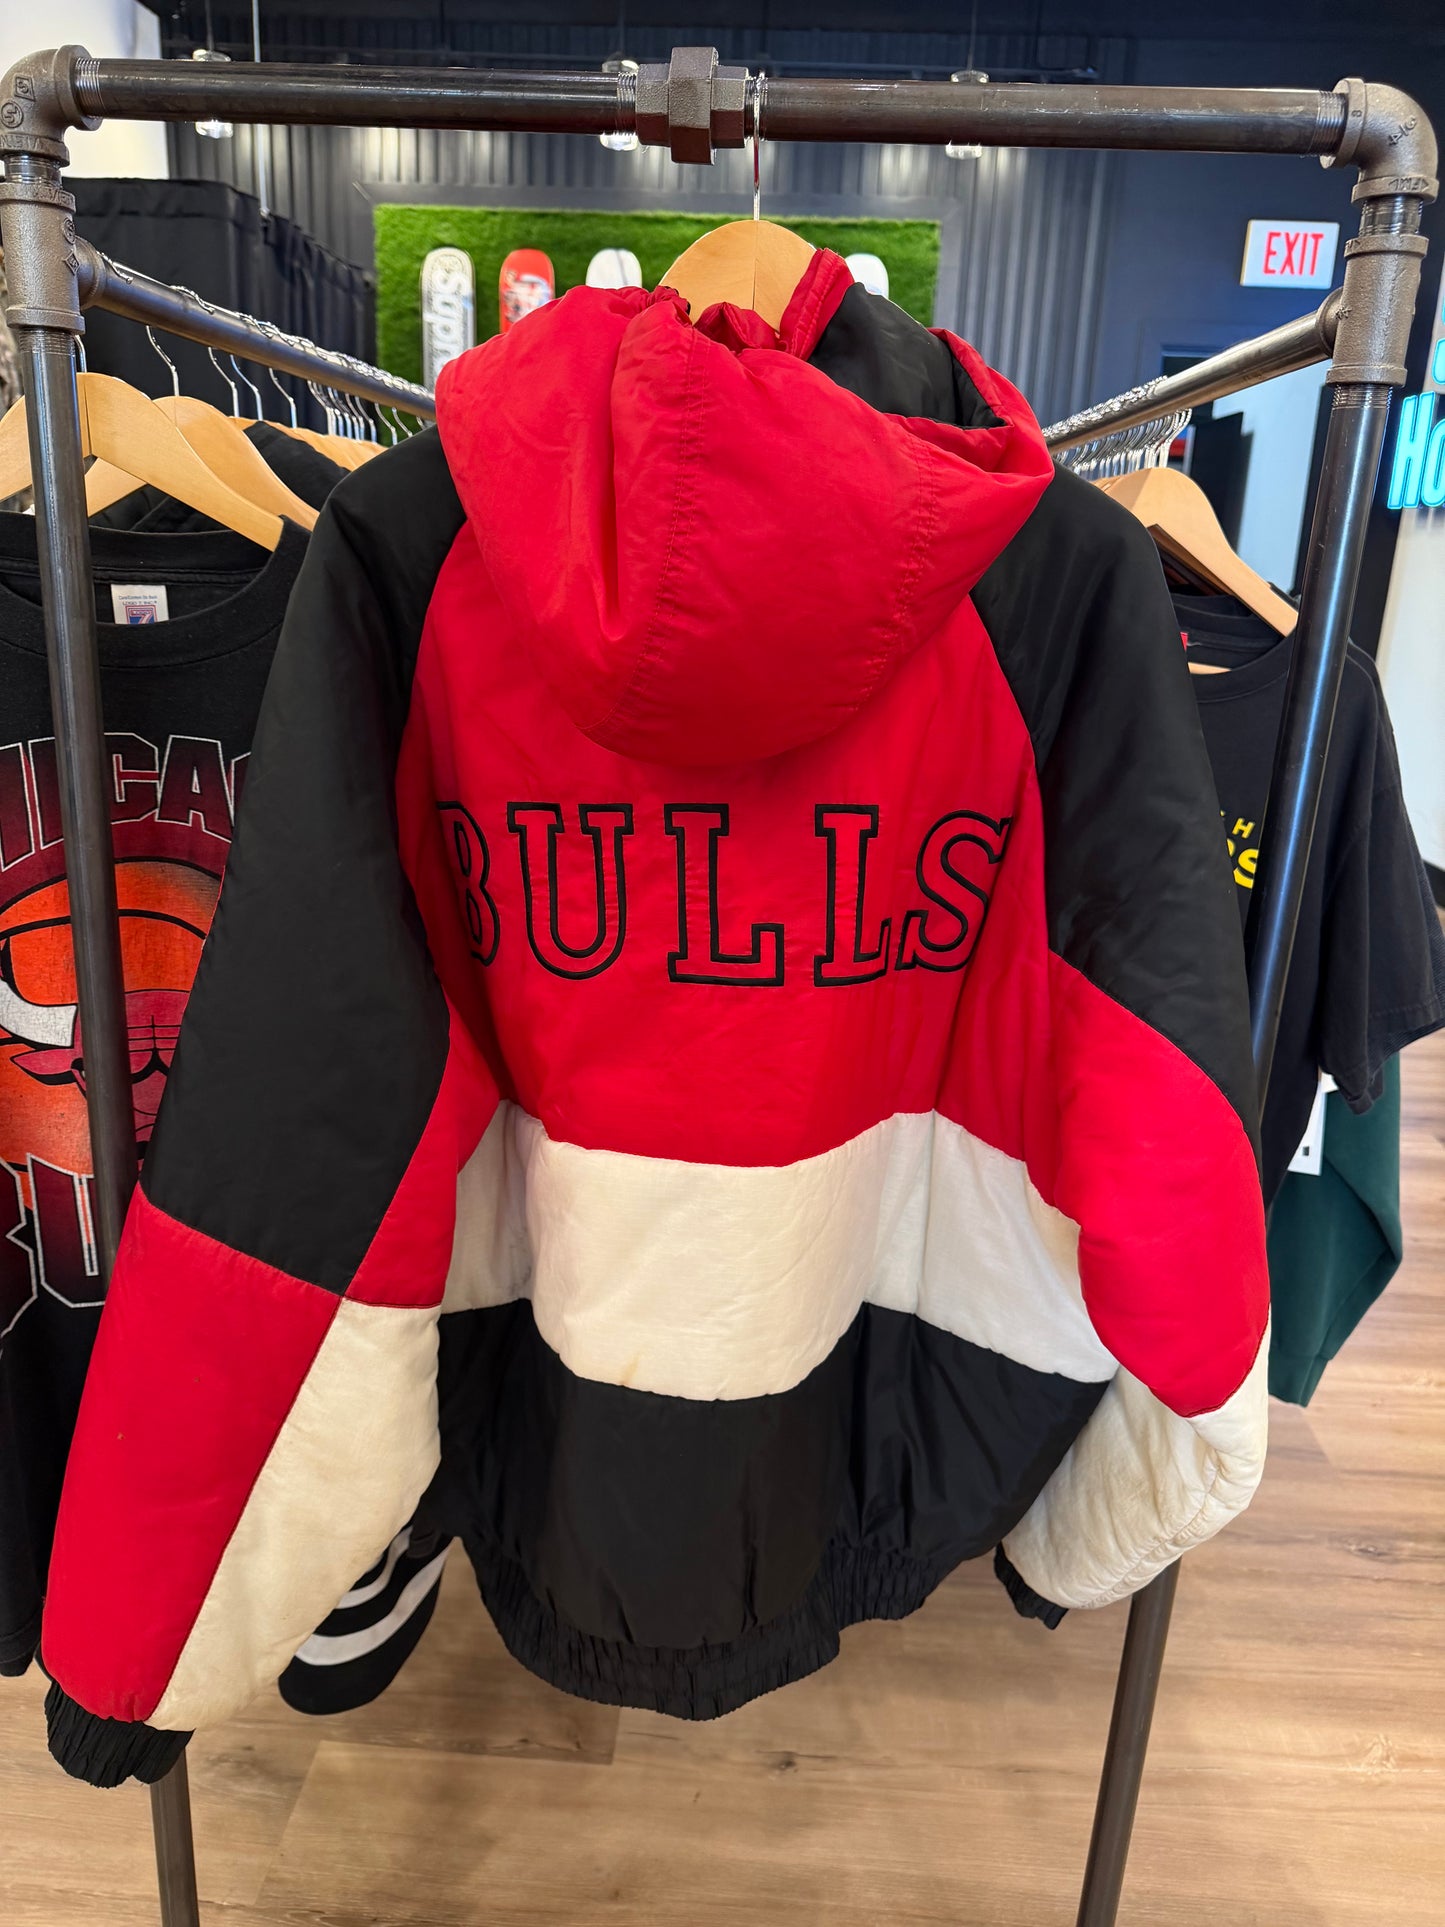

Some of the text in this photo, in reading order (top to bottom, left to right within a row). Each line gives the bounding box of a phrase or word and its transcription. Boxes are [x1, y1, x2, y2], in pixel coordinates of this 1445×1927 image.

[1263, 231, 1324, 276] EXIT
[423, 268, 470, 373] Supr
[437, 801, 1011, 987] BULLS
